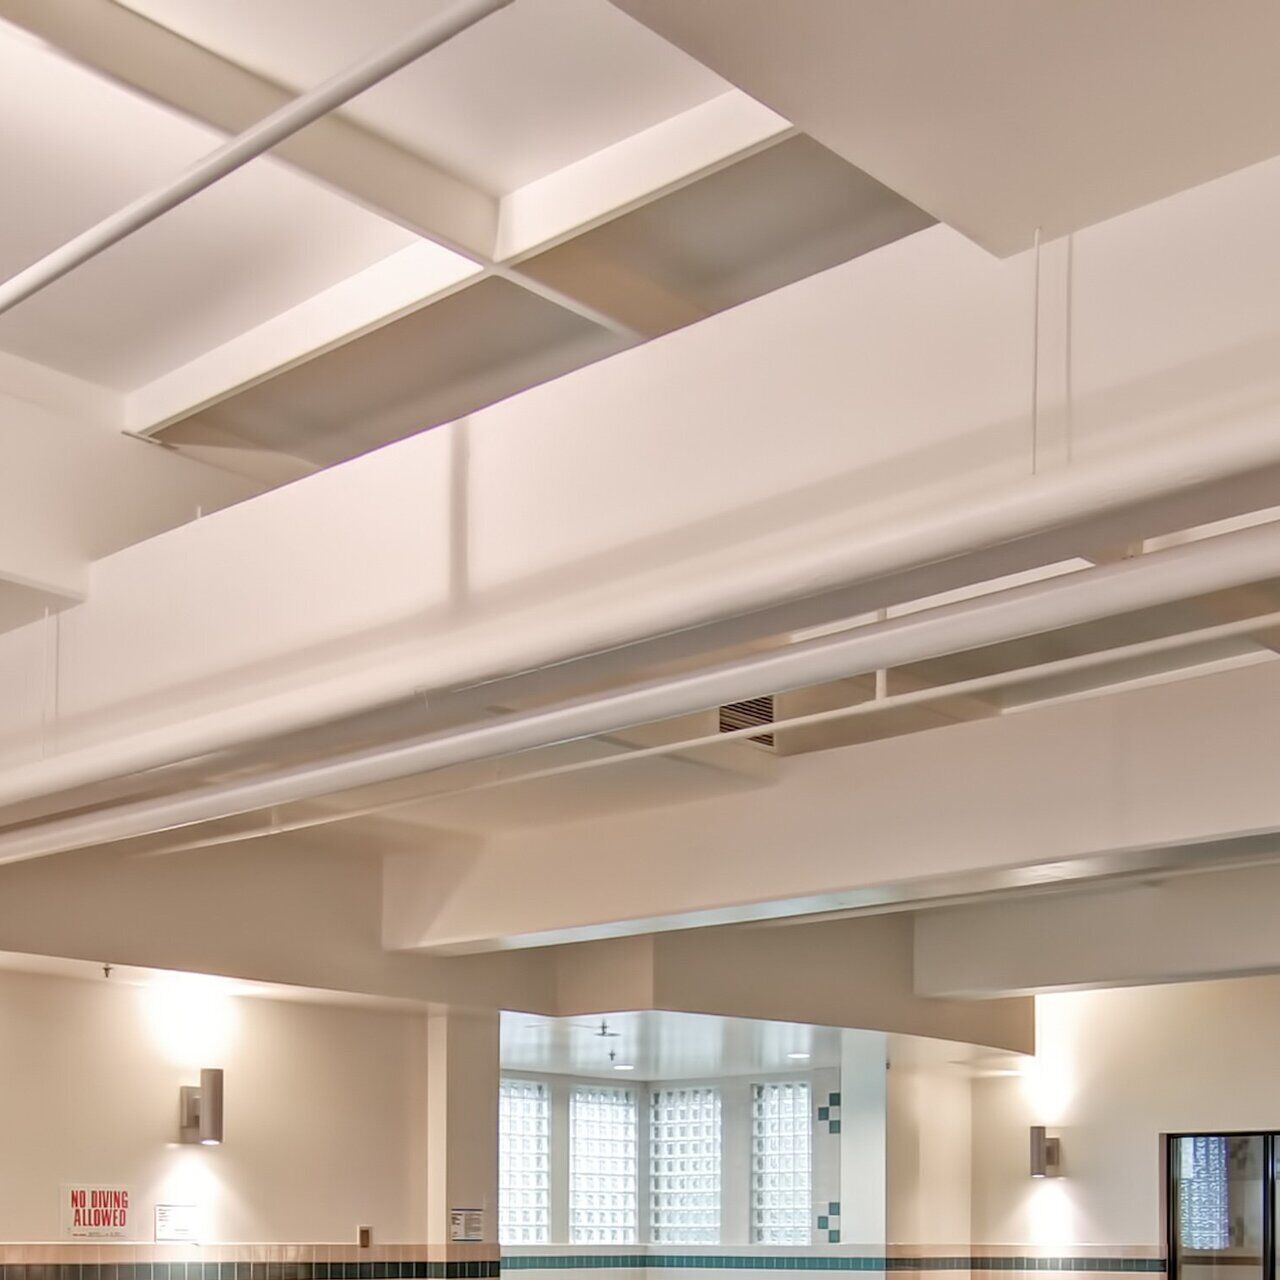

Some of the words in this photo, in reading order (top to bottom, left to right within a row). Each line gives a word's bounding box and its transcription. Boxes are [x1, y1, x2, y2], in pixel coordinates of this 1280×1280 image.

[71, 1190, 86, 1208] NO
[91, 1190, 128, 1208] DIVING
[73, 1208, 126, 1226] ALLOWED
